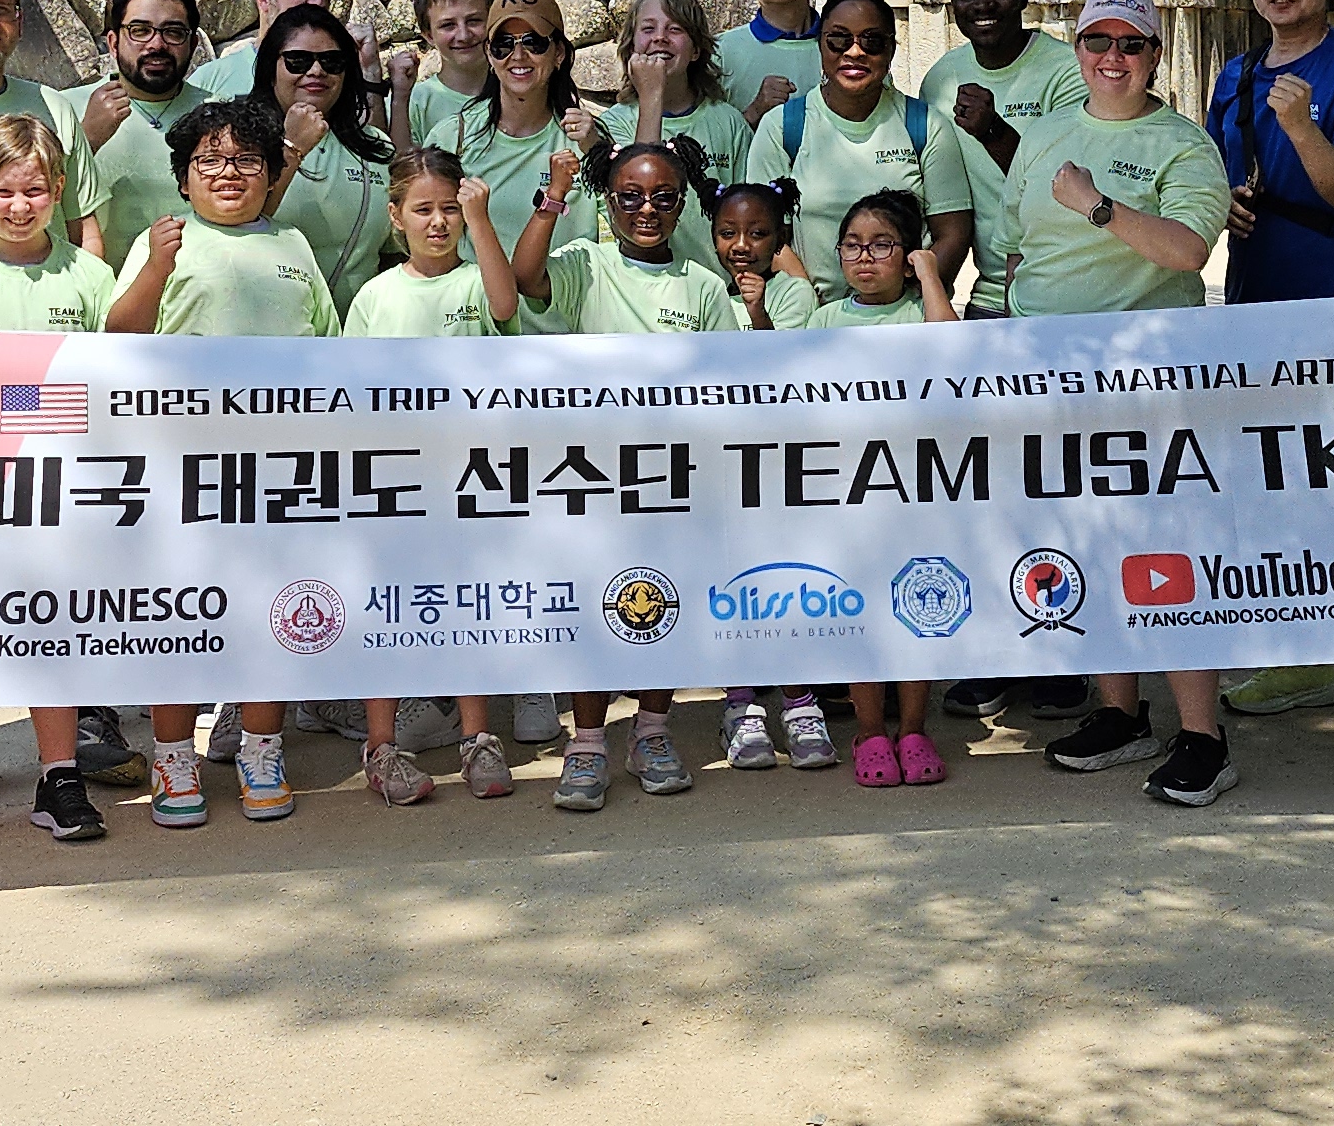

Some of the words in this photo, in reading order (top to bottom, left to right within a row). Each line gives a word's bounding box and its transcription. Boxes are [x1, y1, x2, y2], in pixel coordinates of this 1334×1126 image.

[875, 149, 900, 158] TEAM
[1112, 160, 1138, 172] TEAM
[1138, 167, 1157, 177] USA
[49, 307, 76, 316] TEAM
[659, 308, 685, 320] TEAM
[110, 389, 210, 417] 2025
[222, 387, 354, 415] KOREA
[364, 387, 450, 412] TRIP
[461, 380, 907, 410] YANGCANDOSOCANYOU
[919, 378, 934, 400] /
[944, 370, 1086, 399] YANG'S
[1094, 362, 1262, 393] MARTIAL
[181, 448, 427, 525] 태권도
[454, 442, 697, 519] 선수단
[723, 436, 990, 509] TEAM
[1023, 428, 1221, 499] USA
[606, 571, 638, 602] YANGCANDO
[639, 570, 675, 601] TAEKWONDO
[1029, 554, 1069, 571] MARTIAL
[1068, 571, 1079, 595] ARTS
[69, 585, 228, 624] UNESCO
[363, 580, 580, 625] 세종대학교
[708, 584, 794, 620] bliss
[800, 582, 865, 618] bio
[75, 629, 225, 656] Taekwondo
[363, 631, 446, 649] SEJONG
[451, 626, 580, 646] UNIVERSITY
[715, 628, 782, 640] HEALTHY
[791, 628, 799, 638] &
[808, 626, 865, 637] BEAUTY
